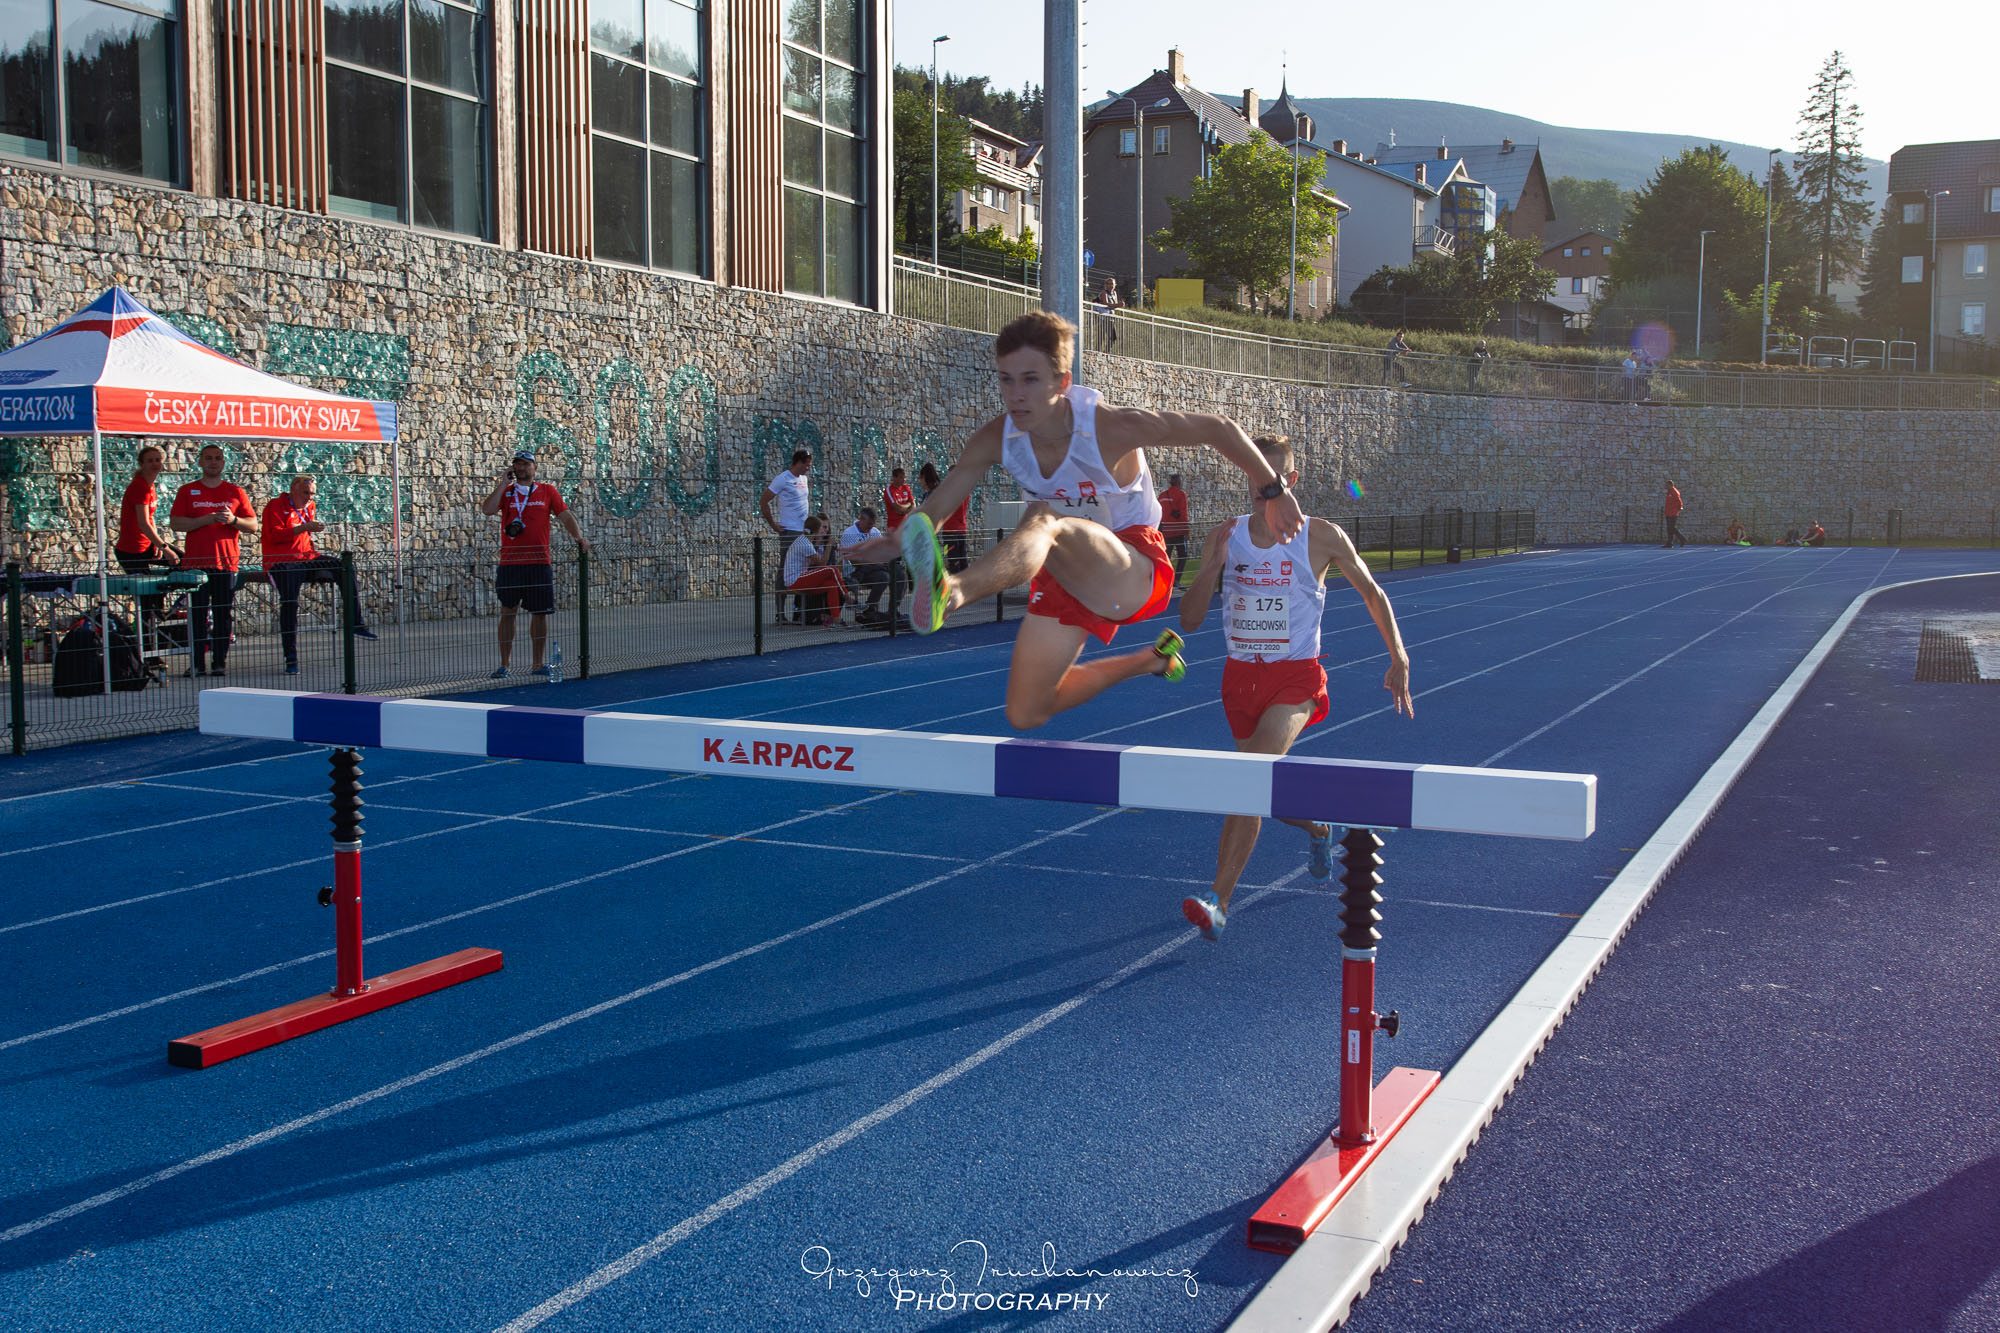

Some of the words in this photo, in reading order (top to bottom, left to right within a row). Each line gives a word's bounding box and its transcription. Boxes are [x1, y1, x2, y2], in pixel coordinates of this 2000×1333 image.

[0, 395, 75, 421] ERATION
[145, 392, 210, 425] ČESKÝ
[214, 401, 312, 429] ATLETICKÝ
[318, 406, 361, 432] SVAZ
[1237, 576, 1291, 587] POLSKA
[1256, 598, 1283, 612] 175
[703, 738, 855, 772] KARPACZ
